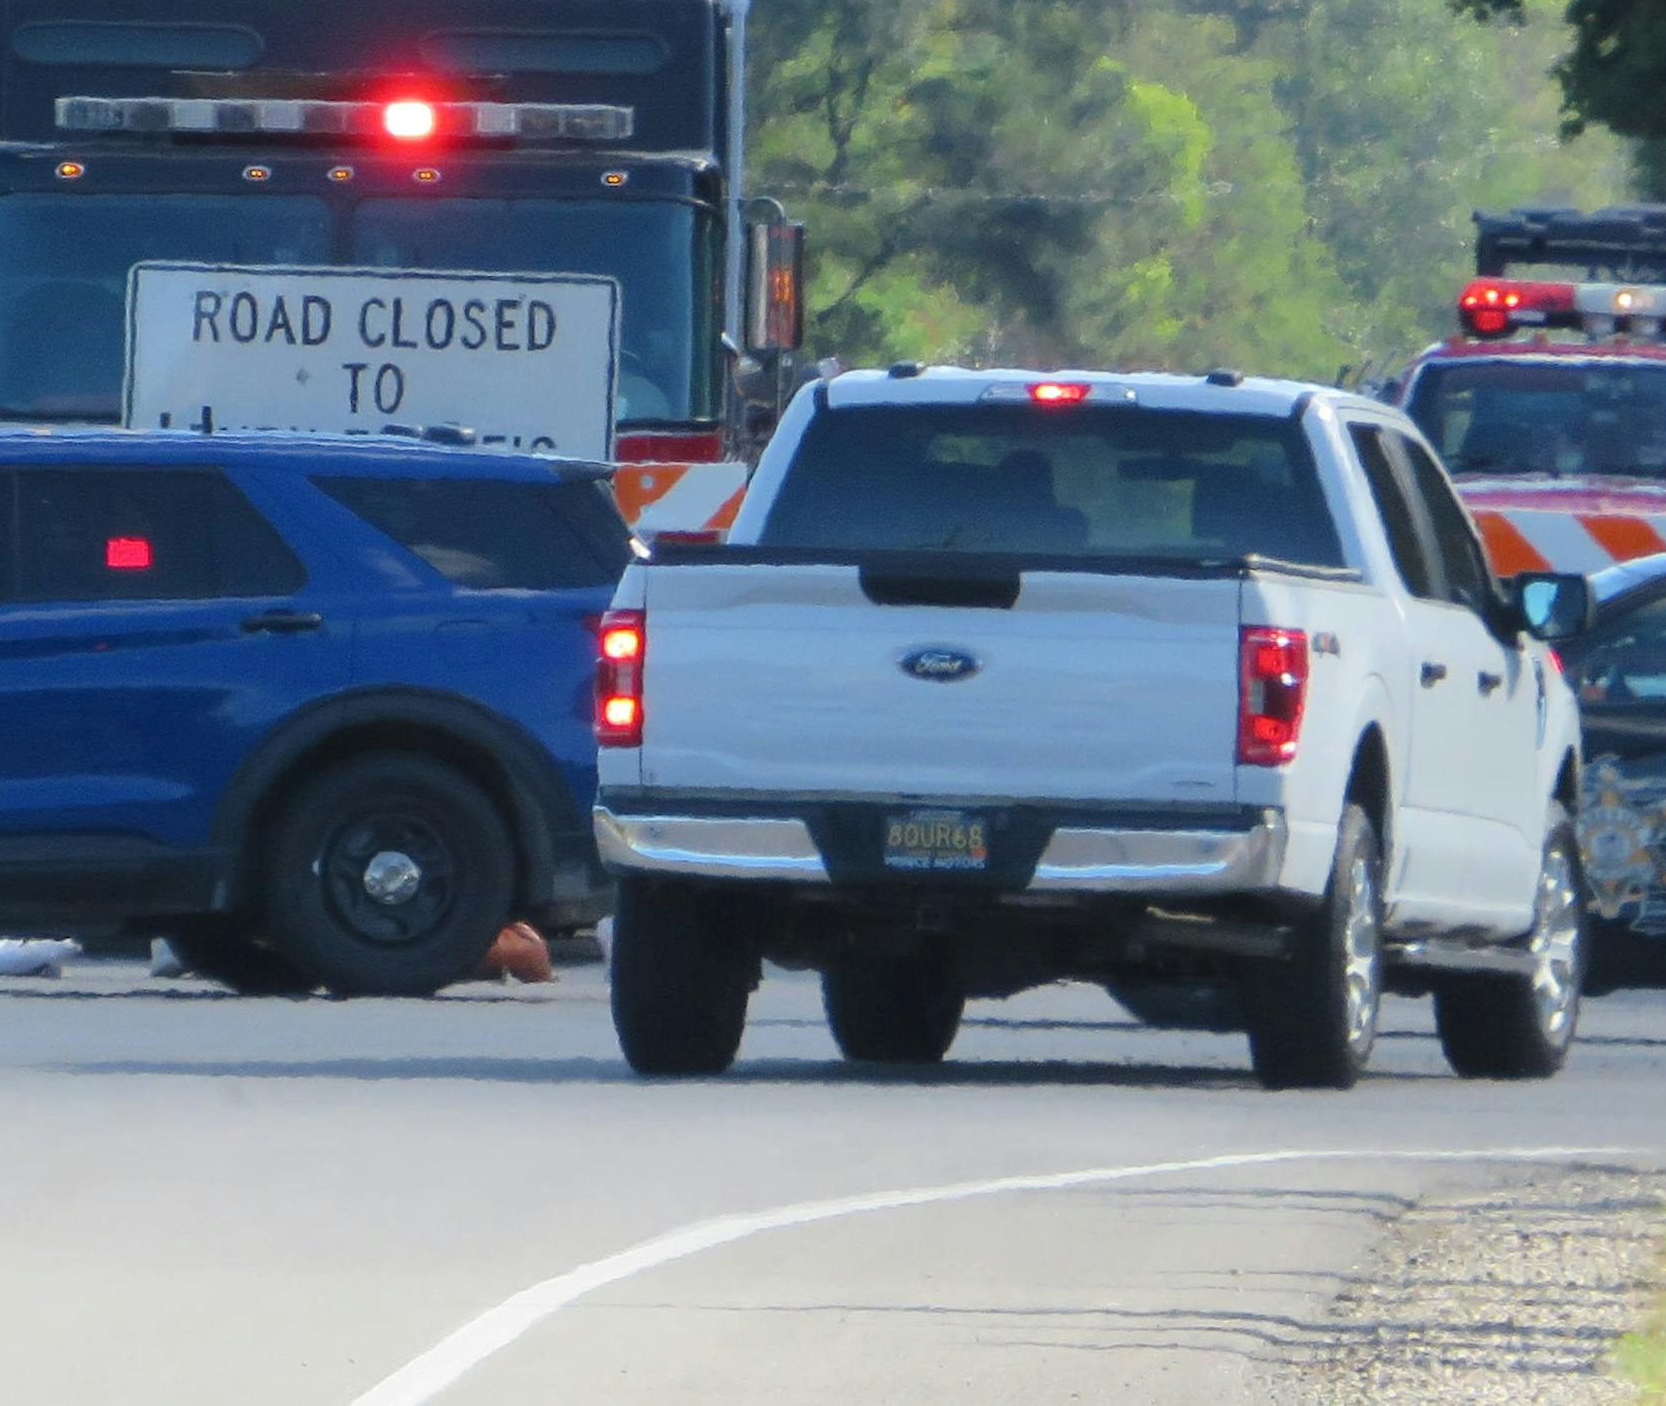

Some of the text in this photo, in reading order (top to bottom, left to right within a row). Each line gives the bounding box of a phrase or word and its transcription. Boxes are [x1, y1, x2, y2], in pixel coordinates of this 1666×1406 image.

[192, 290, 557, 352] ROAD CLOSED
[342, 362, 405, 415] TO
[914, 653, 963, 674] Ford
